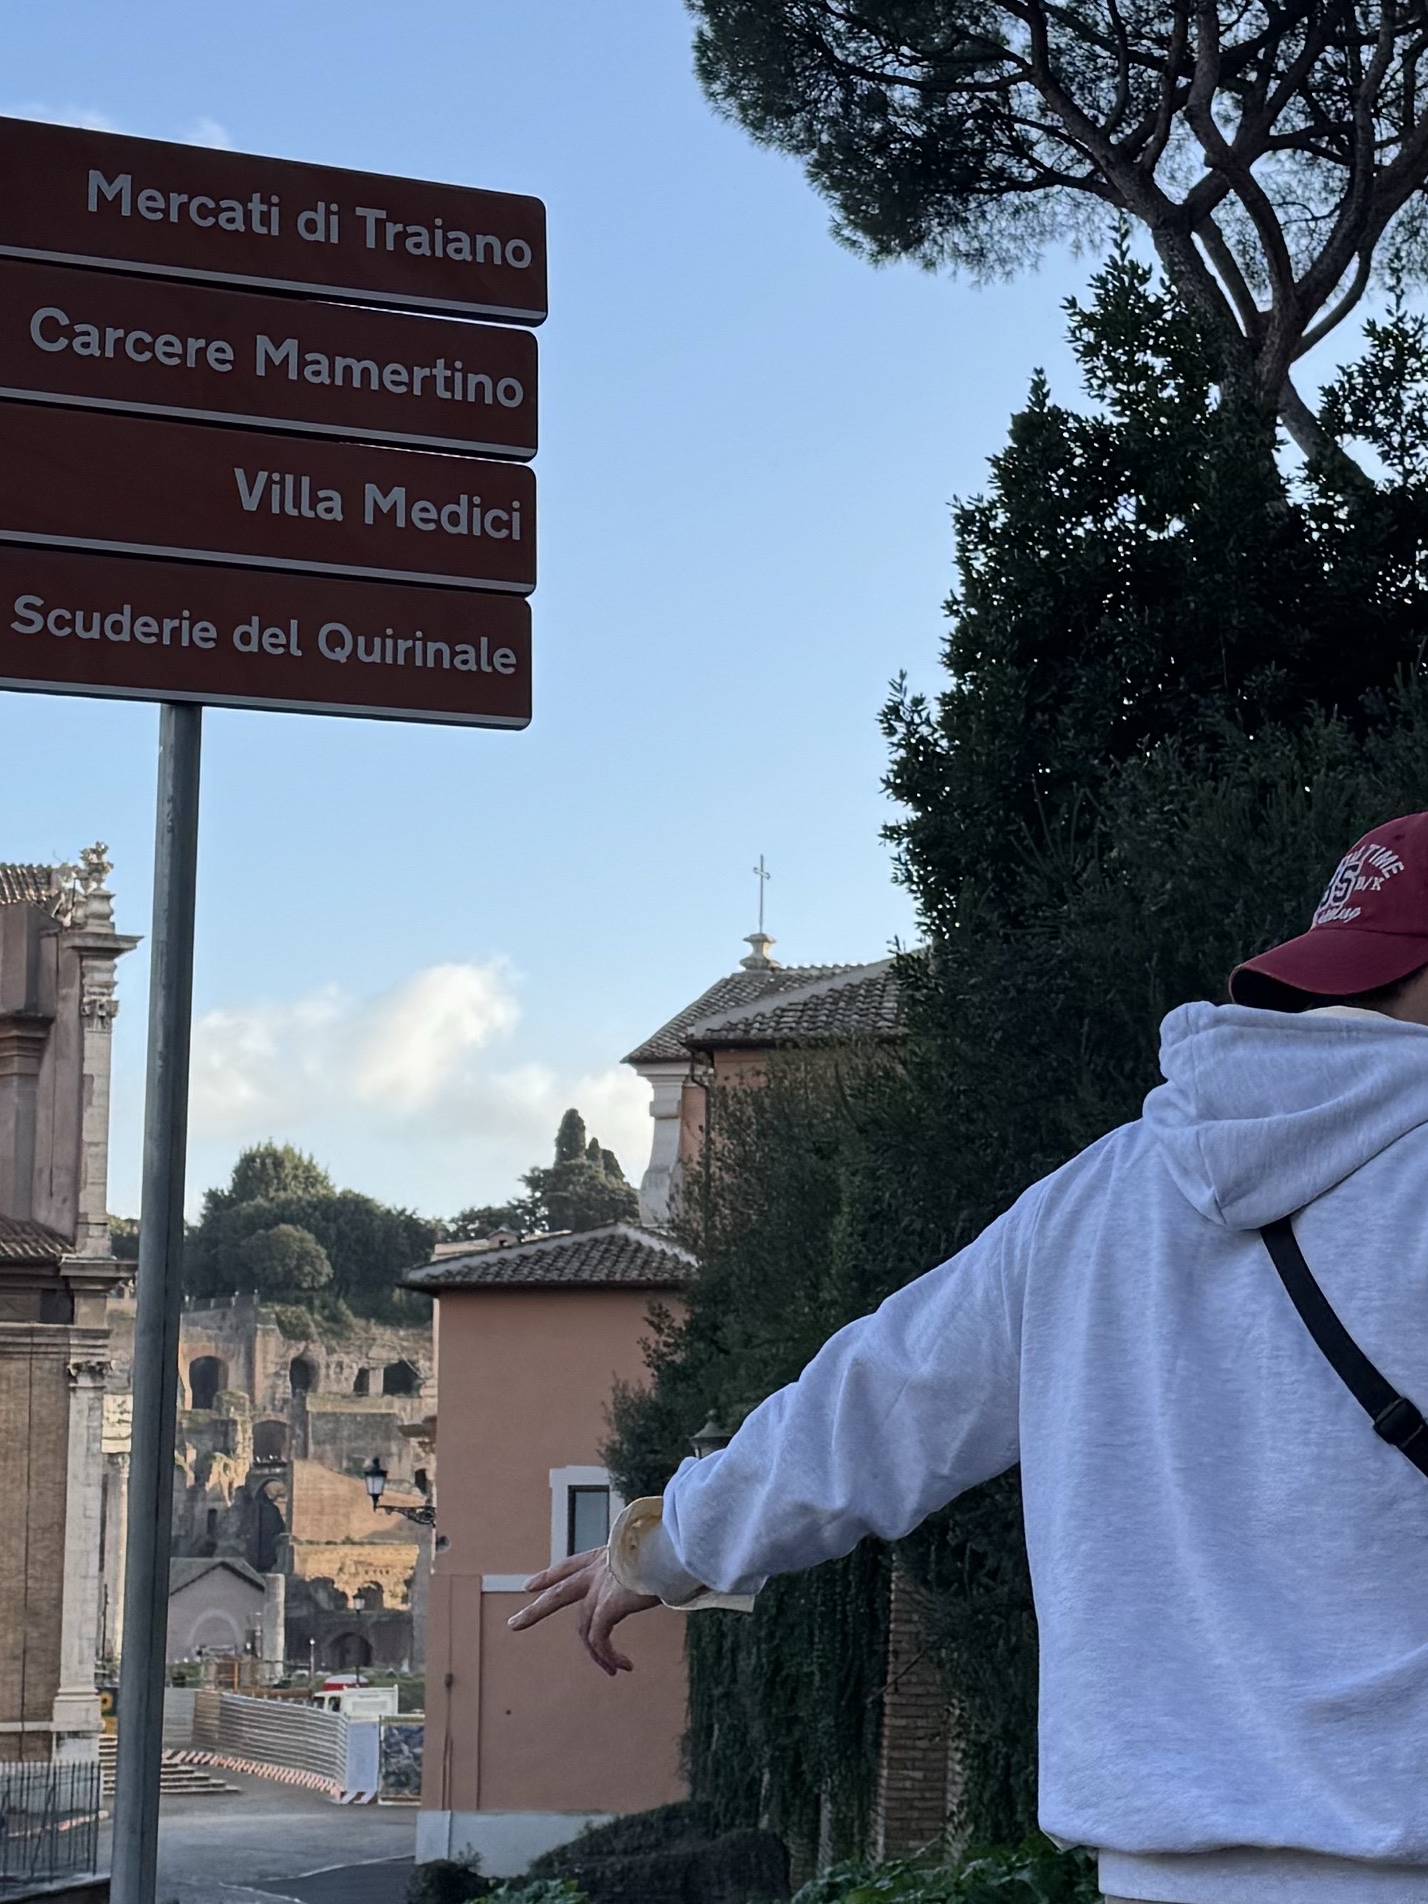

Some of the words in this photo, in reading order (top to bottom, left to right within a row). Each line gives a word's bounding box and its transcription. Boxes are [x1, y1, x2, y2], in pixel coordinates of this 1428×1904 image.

[87, 169, 280, 236] Mercati
[296, 201, 339, 244] di
[355, 206, 532, 269] Traiano
[29, 307, 235, 372] Carcere
[255, 334, 524, 408] Mamertino
[233, 467, 344, 522] Villa
[364, 483, 521, 541] Medici
[10, 594, 218, 649] Scuderie
[232, 615, 303, 657] del
[317, 622, 517, 675] Quirinale
